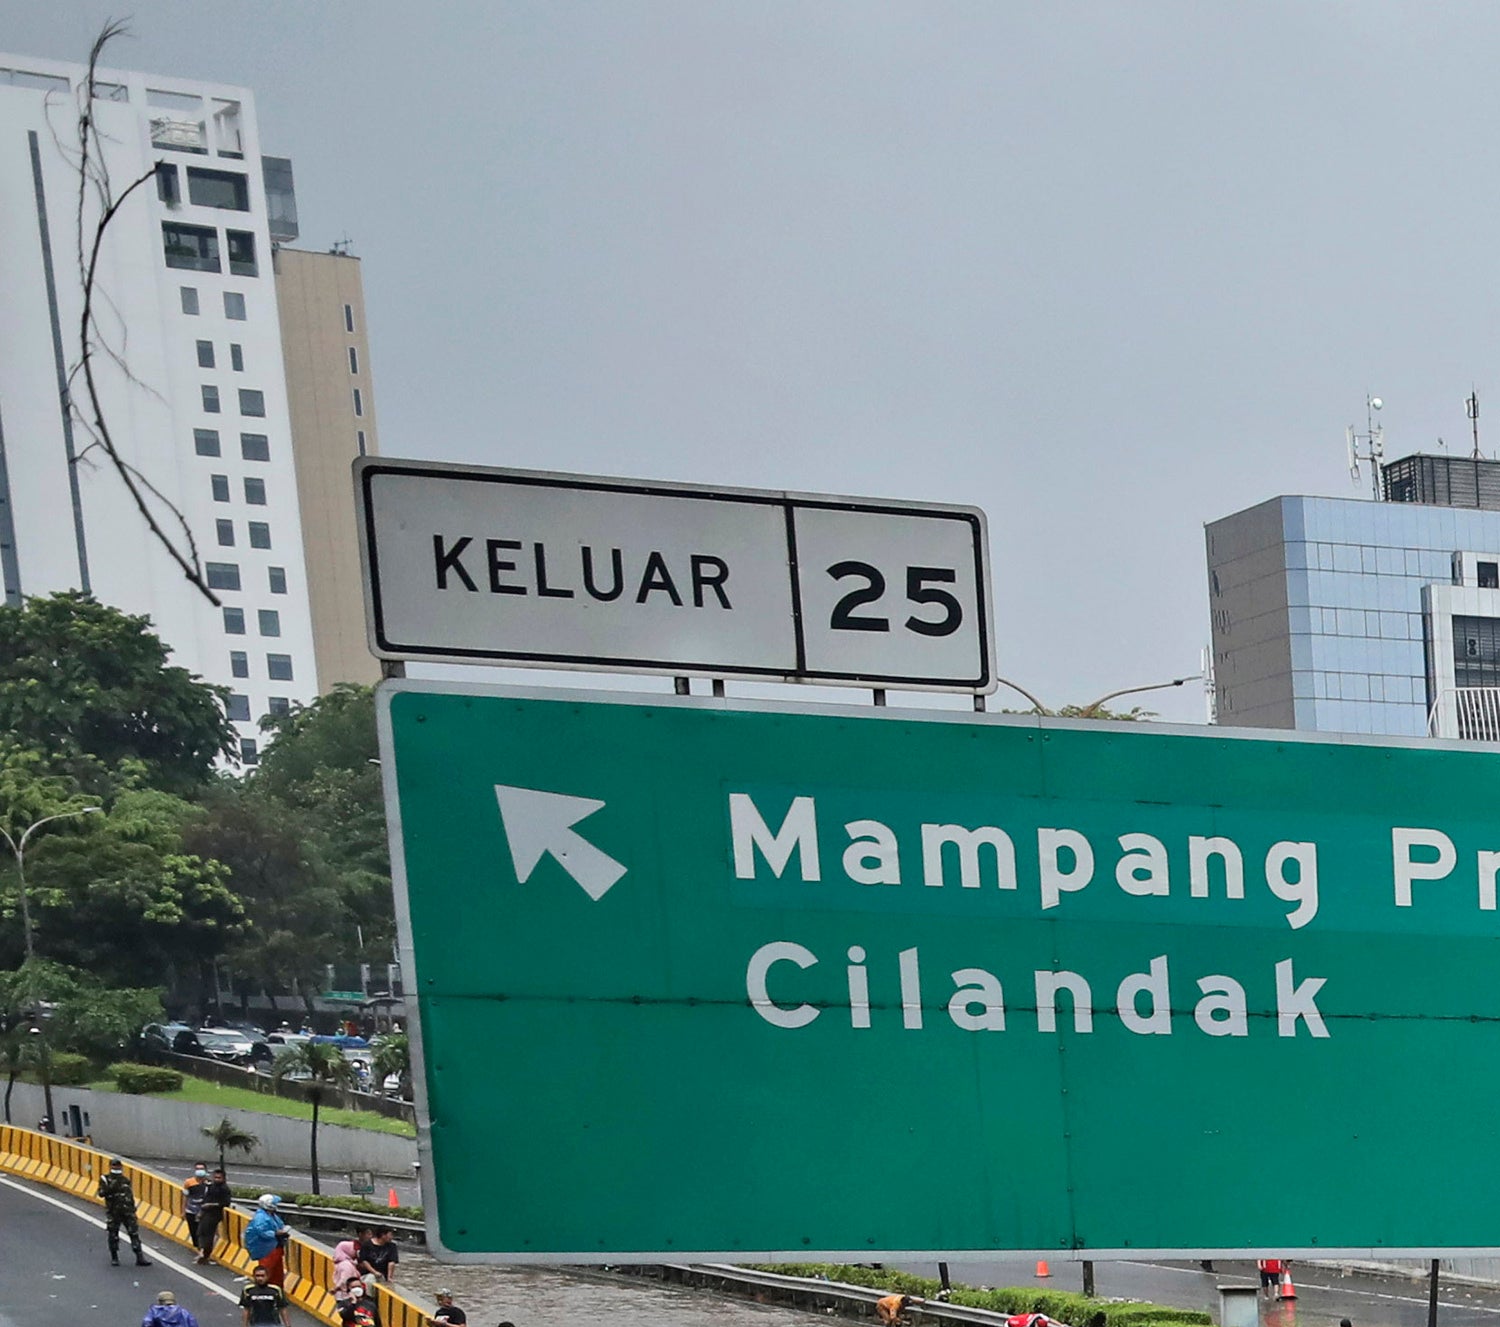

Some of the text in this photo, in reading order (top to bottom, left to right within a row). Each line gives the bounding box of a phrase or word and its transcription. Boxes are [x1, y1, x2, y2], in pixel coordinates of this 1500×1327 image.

[431, 533, 964, 638] KELUAR 25
[728, 792, 1320, 931] Mampang
[745, 940, 1331, 1039] Cilandak
